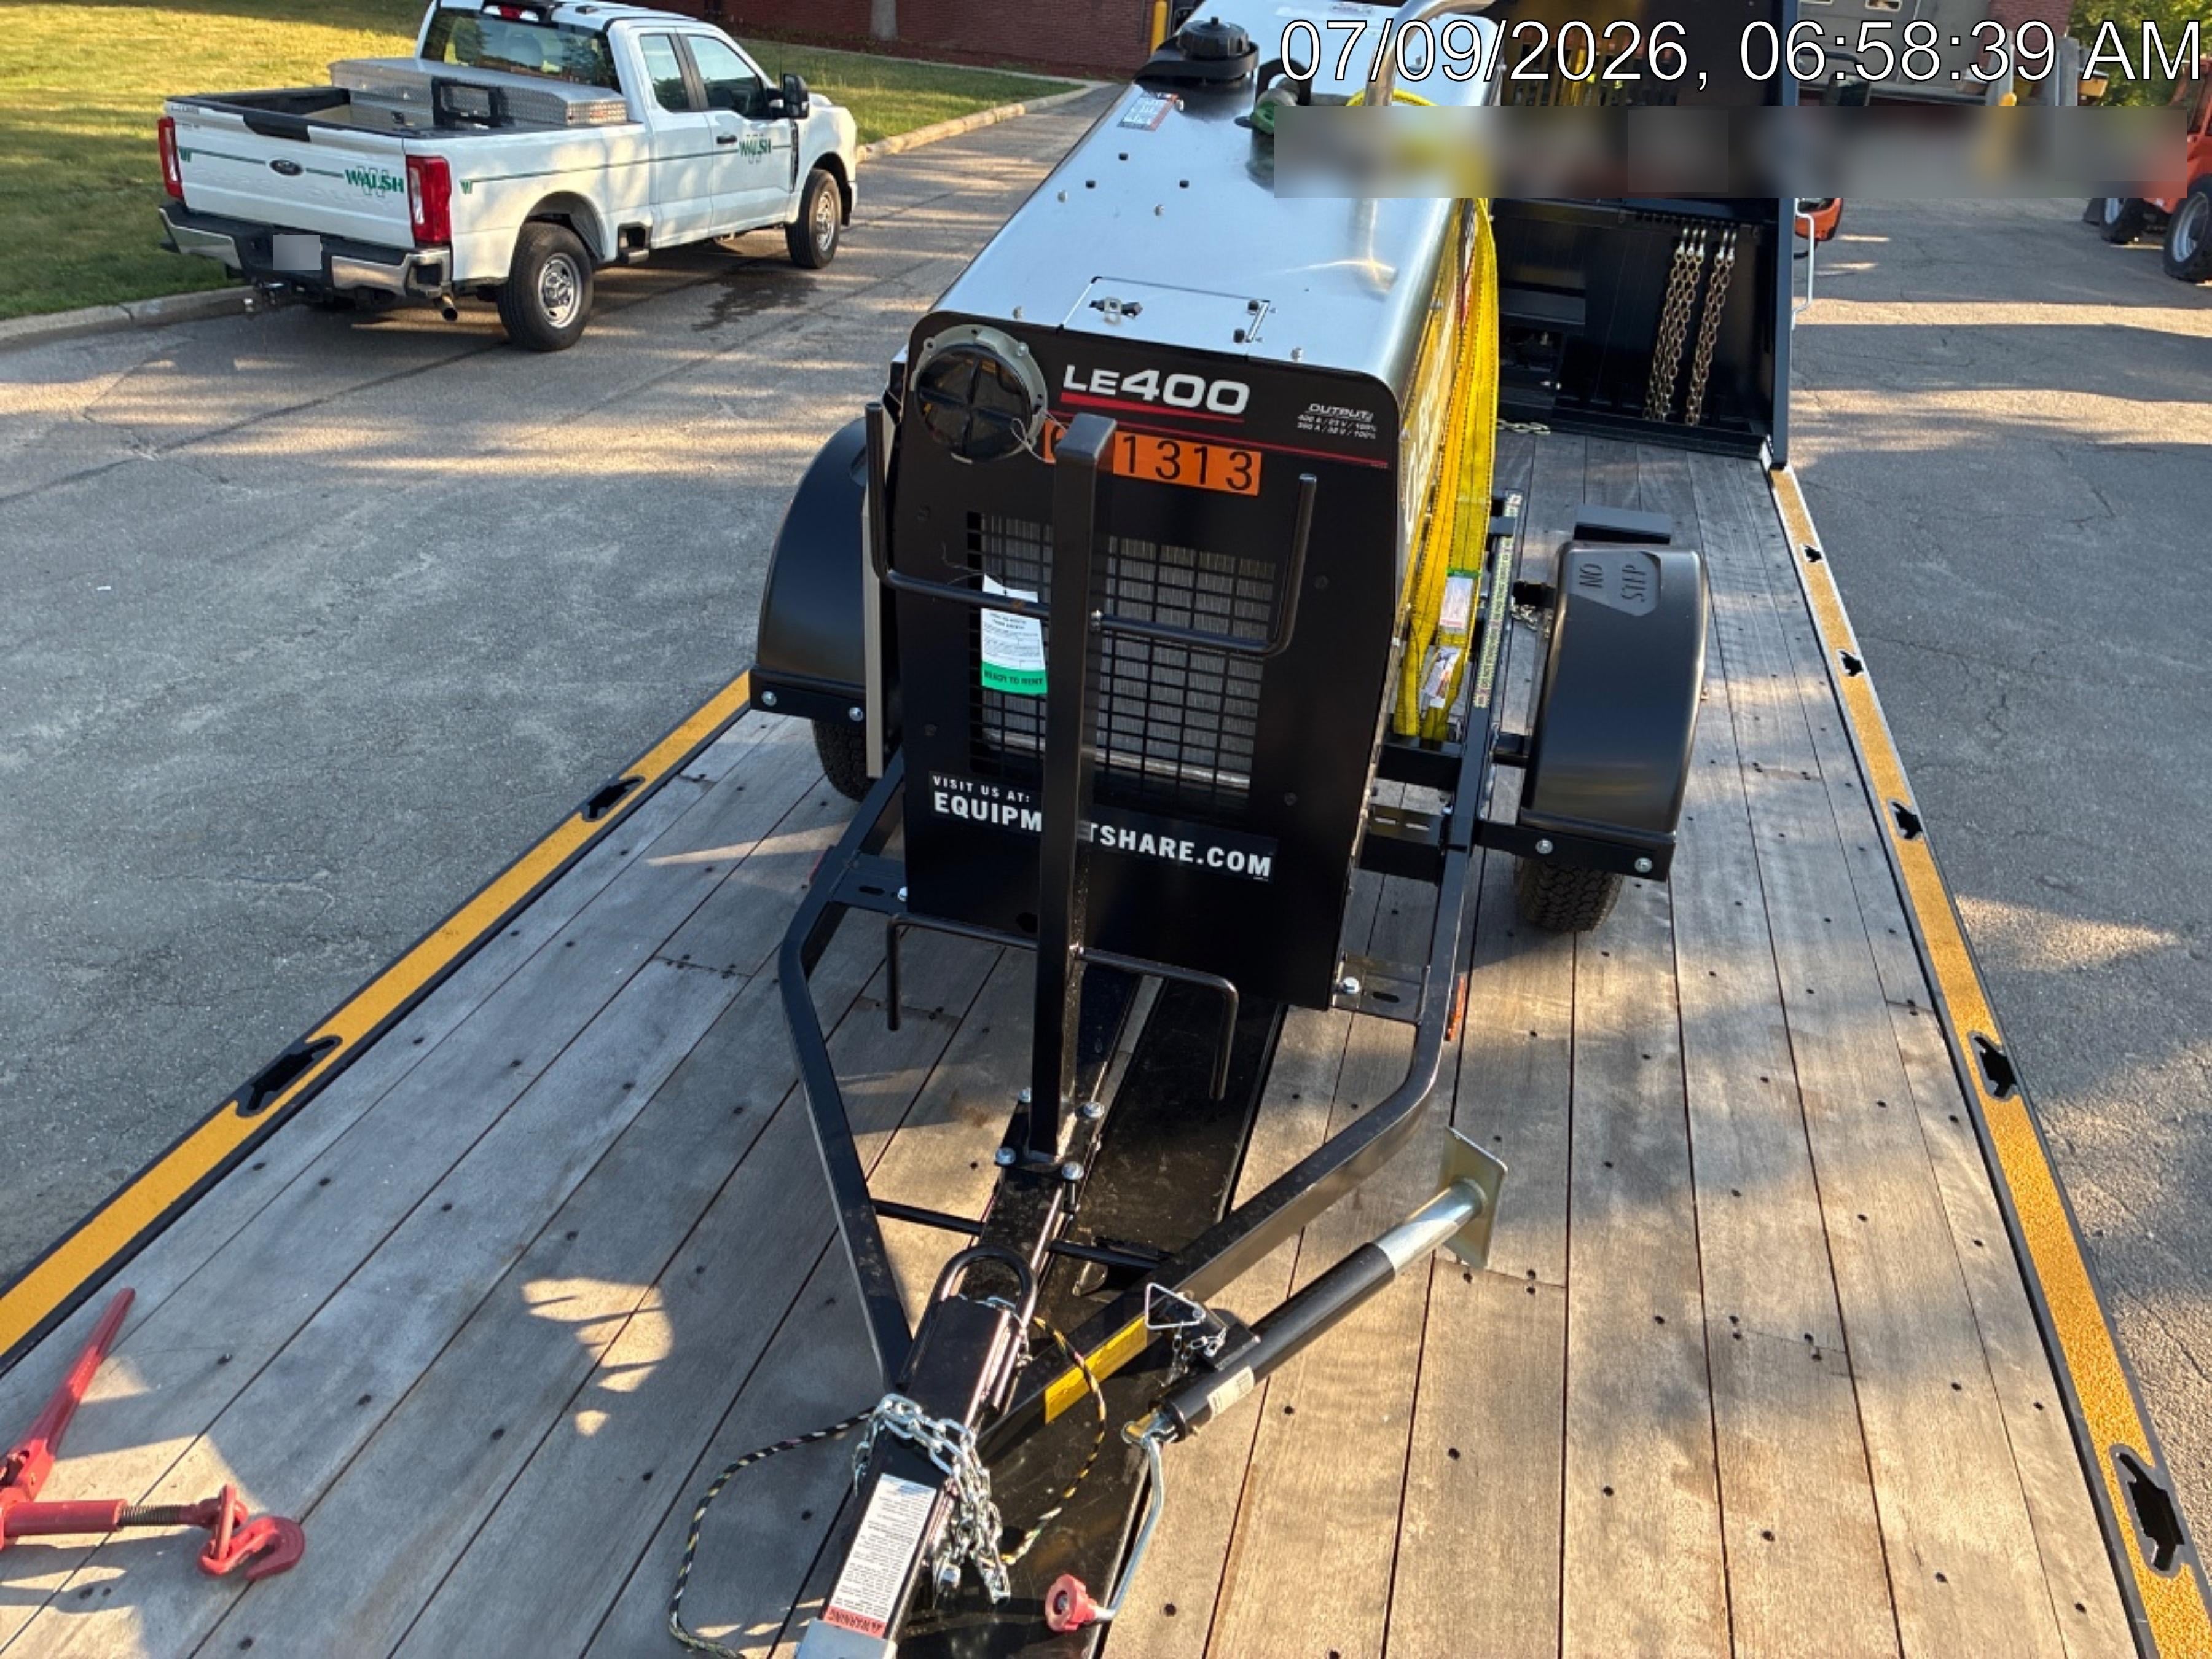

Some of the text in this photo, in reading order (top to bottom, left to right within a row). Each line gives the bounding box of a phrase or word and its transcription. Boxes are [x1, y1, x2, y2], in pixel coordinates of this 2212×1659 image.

[345, 168, 404, 193] WALSH
[1063, 364, 1250, 415] LE400
[1579, 563, 1604, 589] NO
[1620, 563, 1647, 602] STEP
[1009, 675, 1019, 684] TO
[933, 775, 1030, 803] VISIT US AT:
[934, 790, 1271, 877] EQUIPMTSHARE.COM
